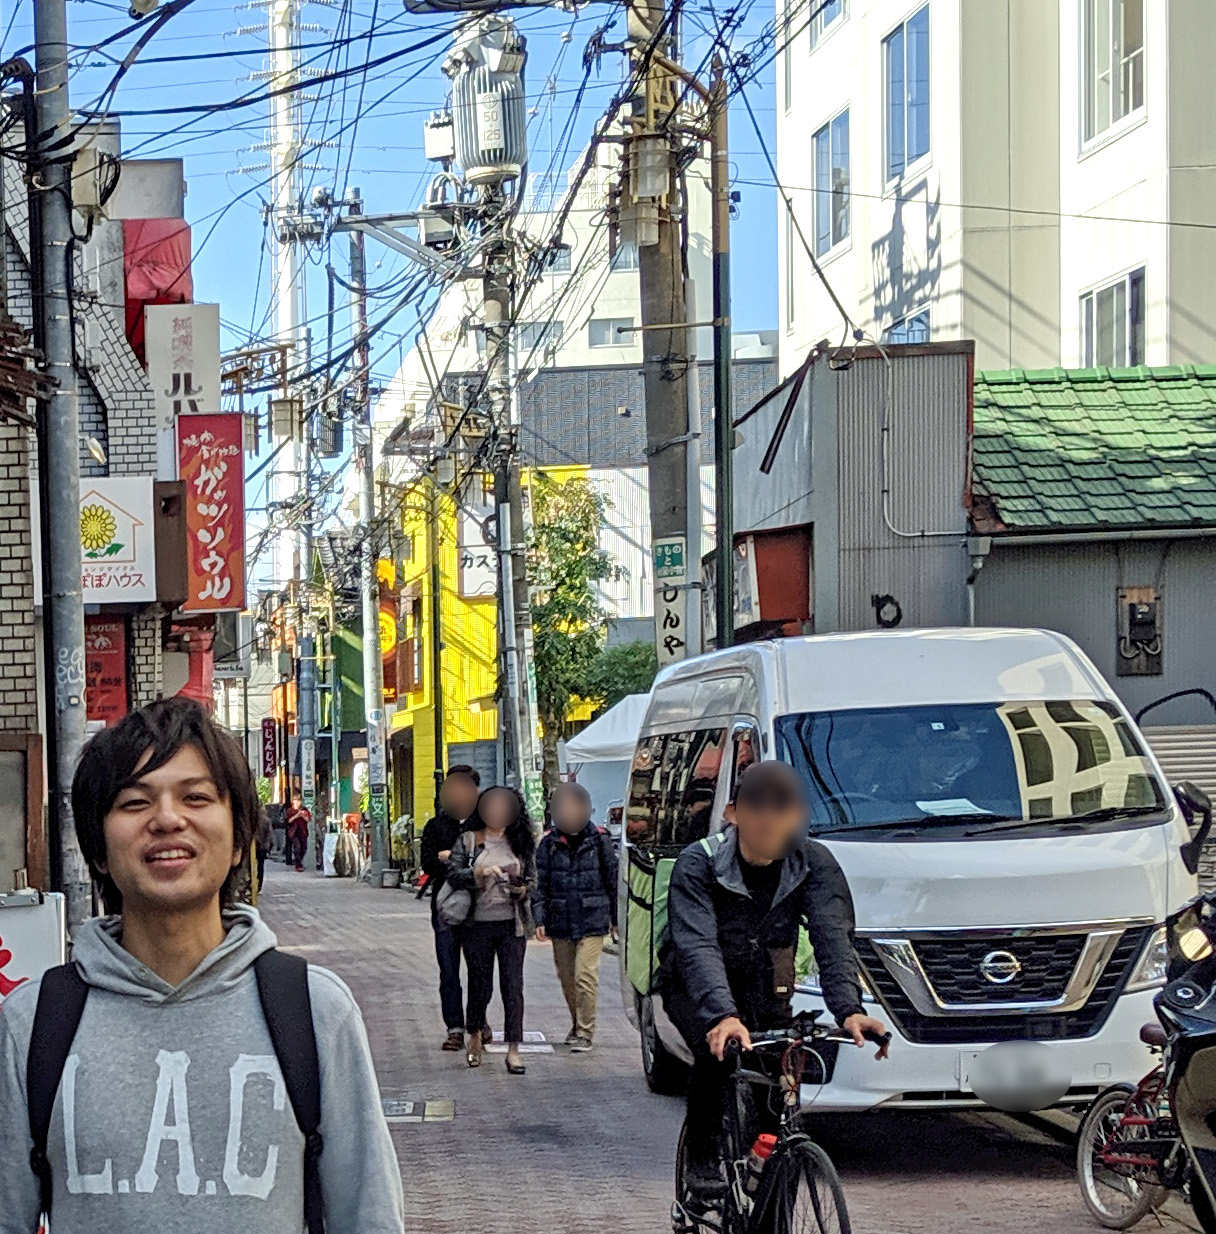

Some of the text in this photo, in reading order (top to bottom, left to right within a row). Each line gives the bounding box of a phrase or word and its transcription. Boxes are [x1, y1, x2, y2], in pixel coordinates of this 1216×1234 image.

[193, 463, 232, 600] ガッツソウル
